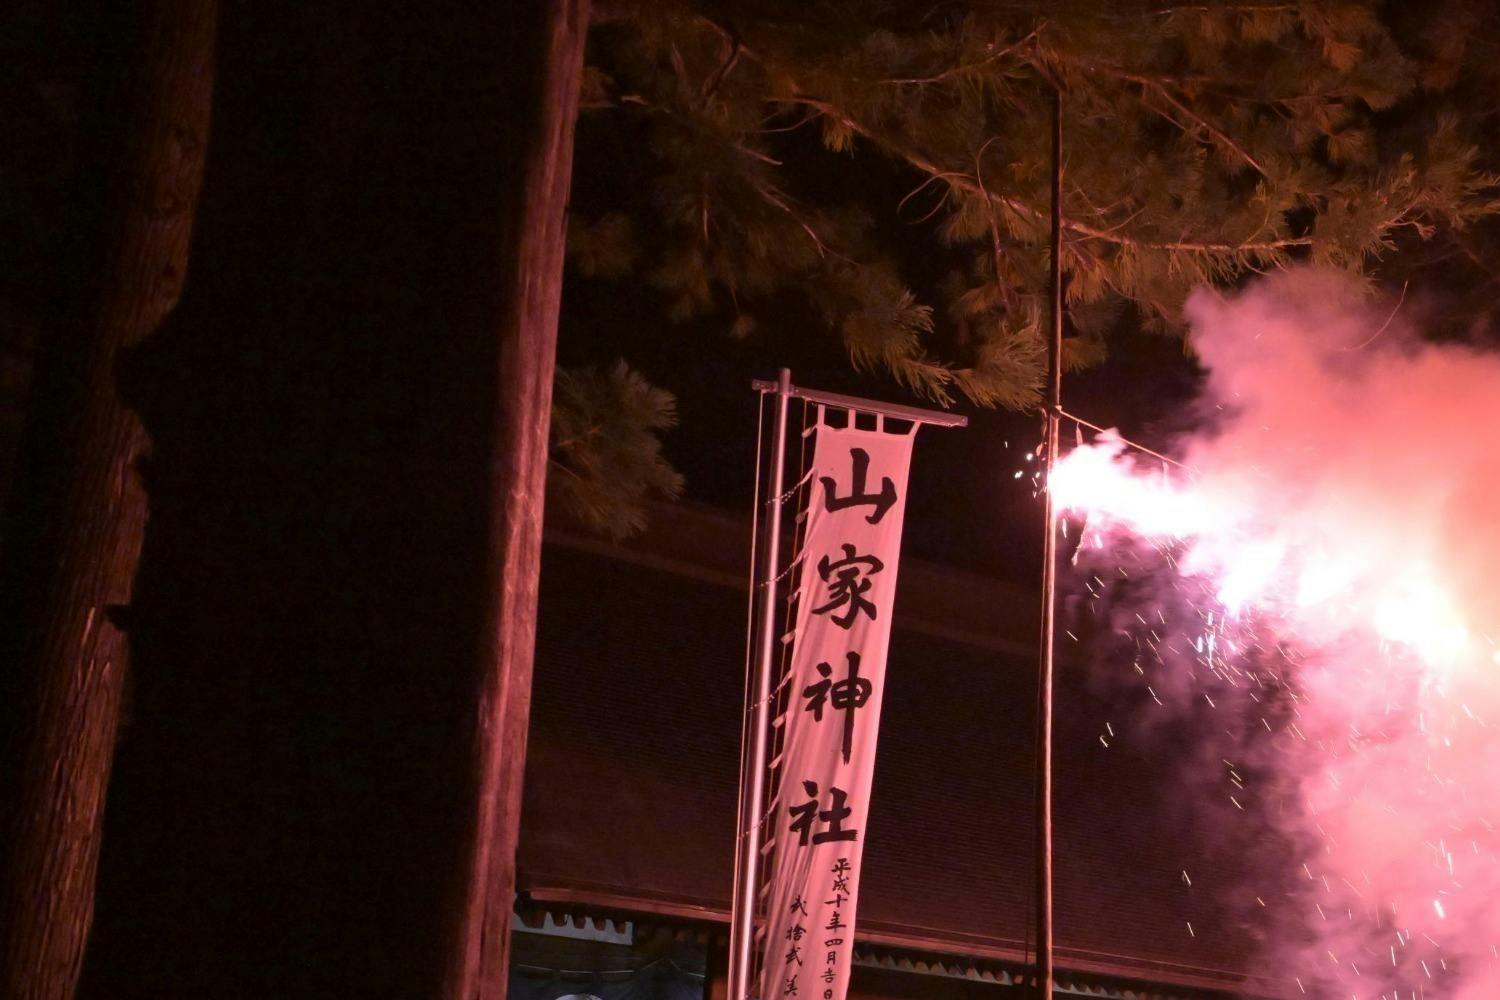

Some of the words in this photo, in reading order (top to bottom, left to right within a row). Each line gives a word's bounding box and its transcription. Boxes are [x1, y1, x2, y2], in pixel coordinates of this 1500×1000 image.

[789, 448, 898, 846] 山家神社
[820, 857, 851, 1000] 平成十年四月吉日
